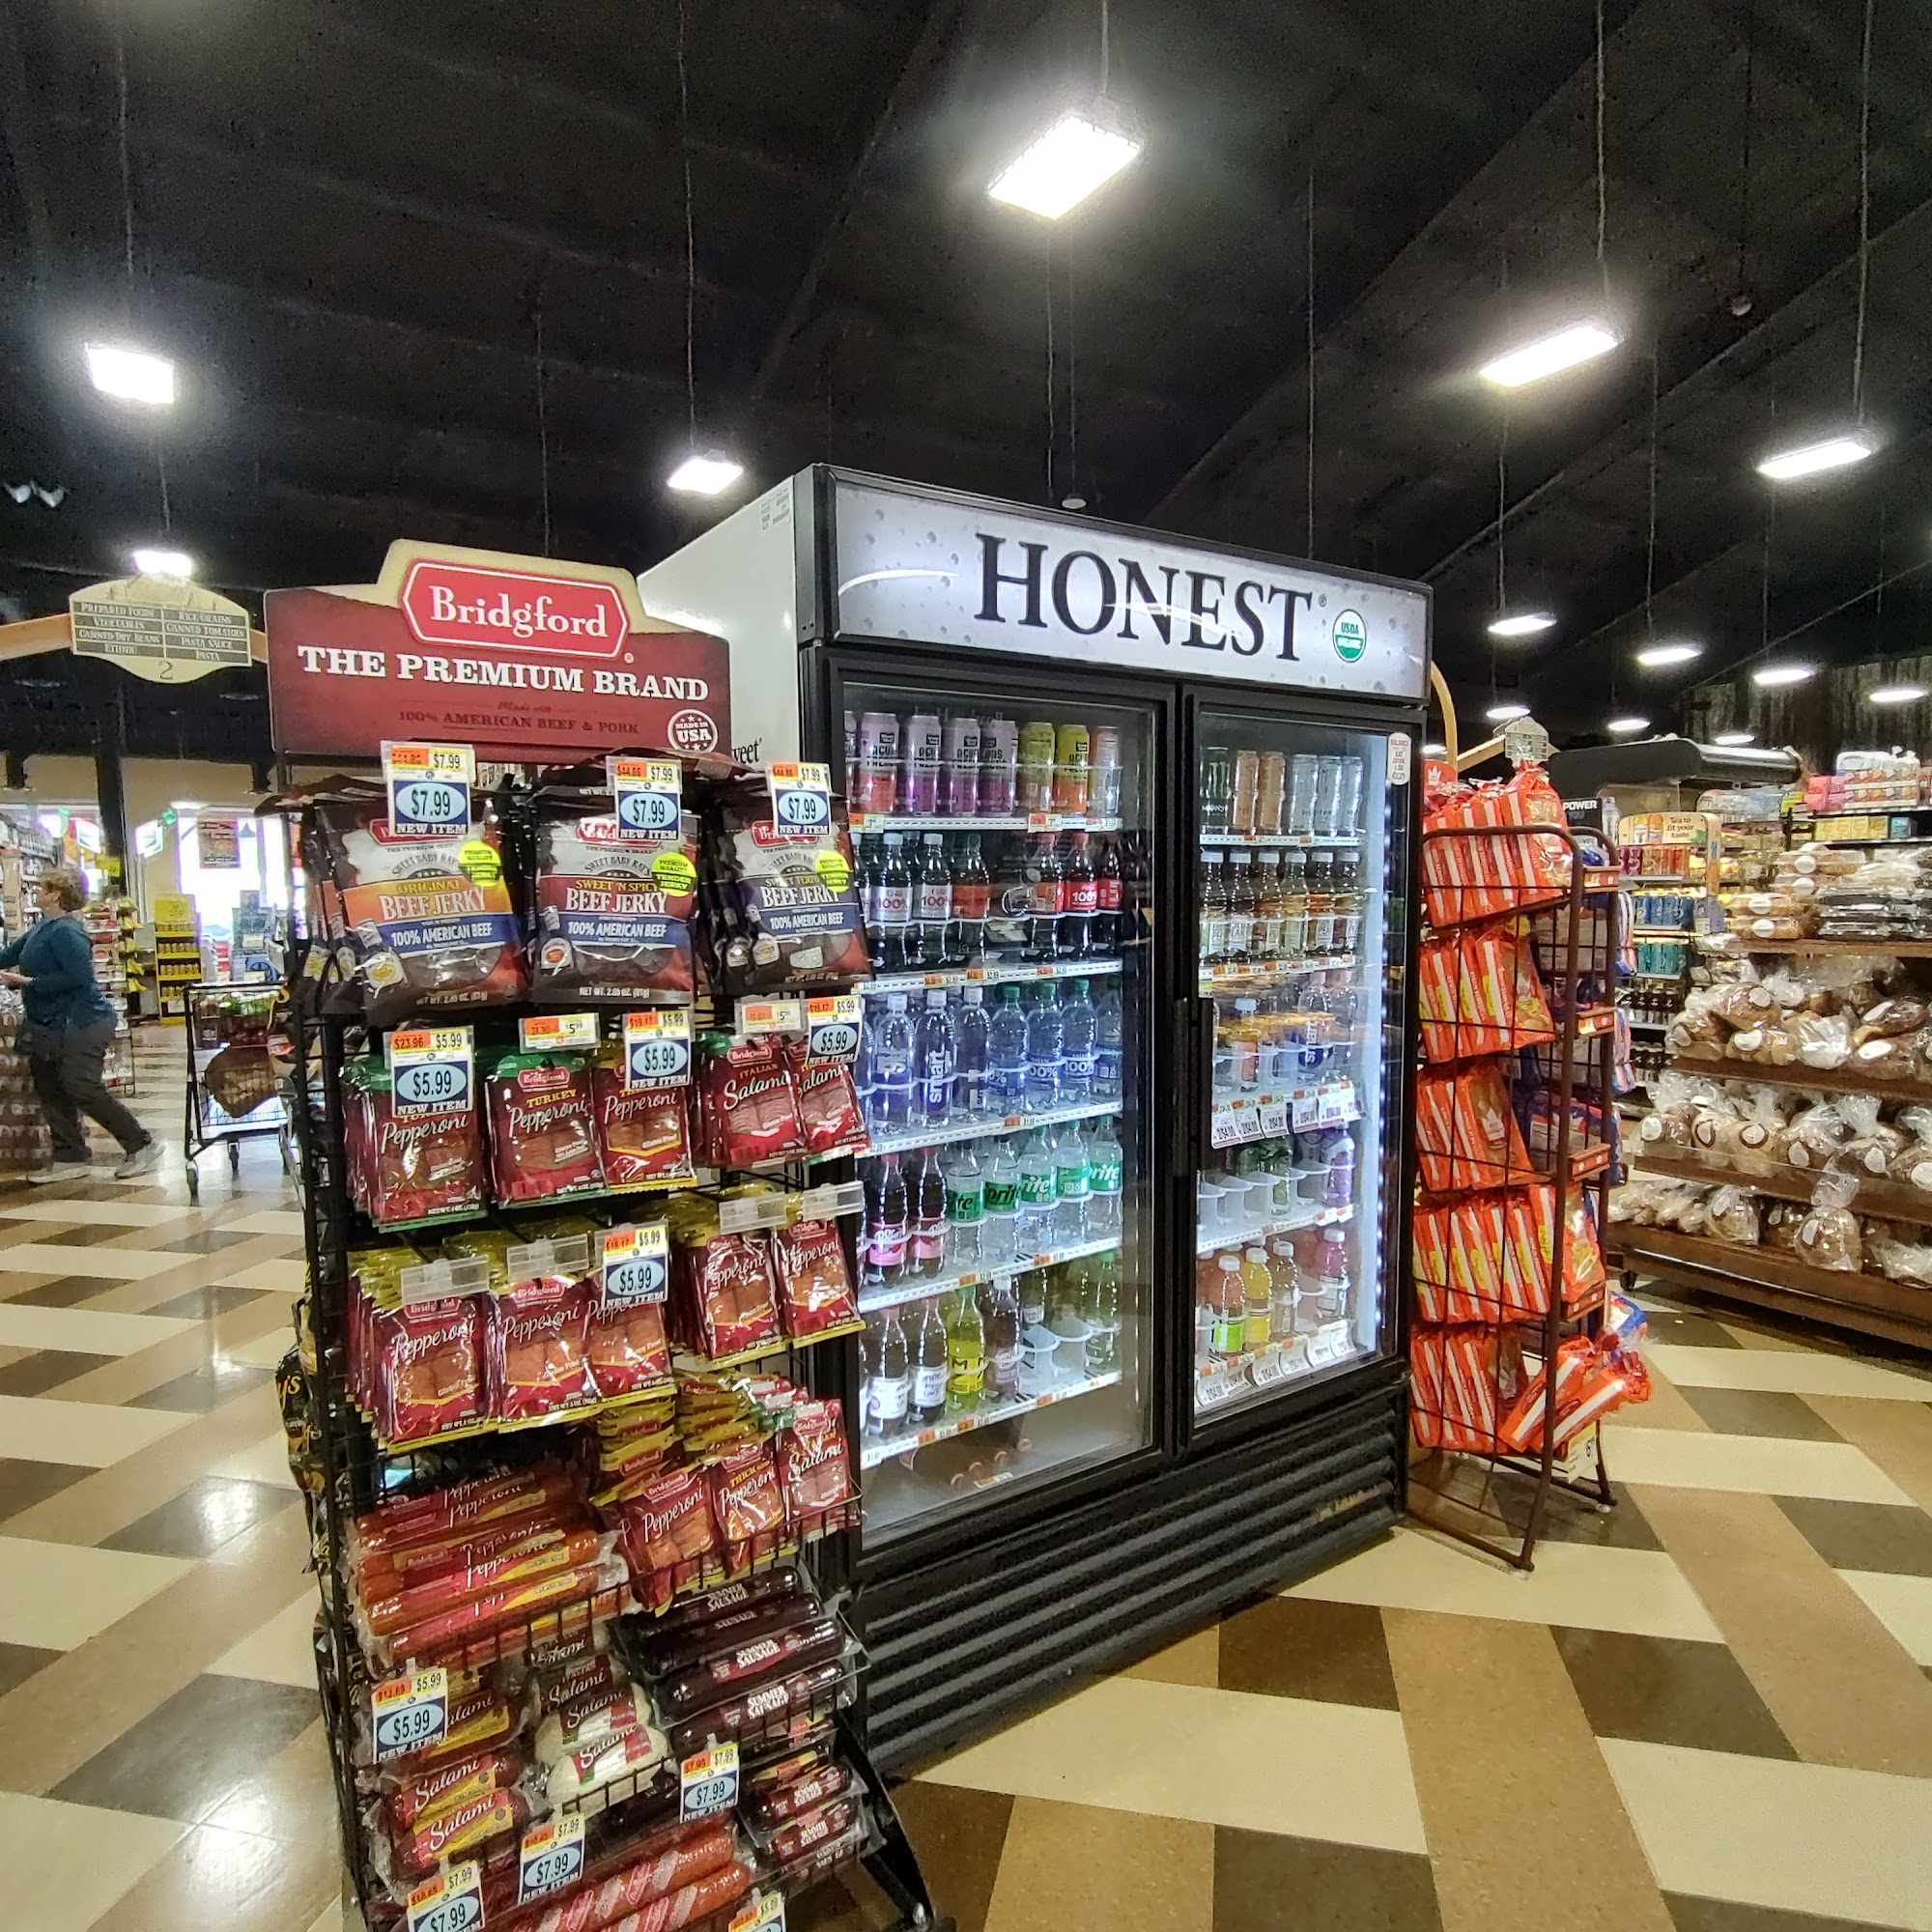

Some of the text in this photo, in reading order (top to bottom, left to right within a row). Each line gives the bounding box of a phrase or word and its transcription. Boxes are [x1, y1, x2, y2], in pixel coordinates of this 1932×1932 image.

[975, 532, 1312, 662] HONEST
[429, 584, 608, 639] Bridgford
[1341, 622, 1358, 635] USDA
[196, 650, 220, 661] PASTA
[158, 662, 173, 680] 2
[298, 646, 709, 701] THE PREMIUM BRAND
[398, 711, 438, 723] 100%
[443, 714, 530, 727] AMERICAN
[537, 719, 575, 729] BEEF
[598, 723, 639, 734] PORK
[676, 728, 712, 743] USA
[434, 754, 460, 769] $7.99
[651, 766, 672, 781] $7.99
[412, 789, 450, 818] $7.99
[634, 801, 665, 823] $7.99
[788, 797, 816, 820] $7.99
[1563, 799, 1598, 811] POWER
[396, 824, 466, 834] NEW ITEM
[620, 829, 644, 839] NEW
[648, 830, 677, 839] ITEM
[780, 825, 803, 835] NEW
[806, 825, 828, 835] ITEM
[576, 880, 613, 891] SWEET
[629, 882, 659, 892] SPICY
[760, 887, 798, 907] BEEF
[379, 887, 485, 921] BEEF JERKY
[566, 887, 668, 913] BEEF JERKY
[568, 922, 667, 937] 100% AMERICAN BEEF
[770, 912, 843, 929] 100% AMERICAN BEEF
[390, 923, 494, 947] 100% AMERICAN BEEF
[580, 987, 592, 996] NET
[837, 1001, 855, 1013] $5.99
[663, 1013, 684, 1027] $5.99
[436, 1033, 463, 1048] $5.99
[820, 1030, 848, 1052] $5.99
[644, 1044, 676, 1071] $5.99
[831, 1053, 854, 1063] ITEM
[631, 1074, 687, 1089] NEW ITEM
[739, 1064, 778, 1079] ITALIAN
[412, 1069, 452, 1098] $5.99
[397, 1099, 468, 1116] NEW ITEM
[526, 1089, 577, 1108] TURKEY
[604, 1092, 678, 1125] Pepperoni
[509, 1094, 587, 1138] Pepperoni
[381, 1114, 471, 1155] Pepperoni
[639, 1230, 661, 1246] $5.99
[619, 1267, 652, 1293] $5.99
[607, 1291, 665, 1307] NEW ITEM
[501, 1301, 580, 1344] Pepperoni
[647, 1473, 685, 1495] Bridgford
[729, 1468, 756, 1487] THICK
[642, 1481, 704, 1543] Pepperoni
[707, 1590, 750, 1613] SAUSAGE
[736, 1639, 773, 1660] SUMMER
[737, 1644, 781, 1669] SAUSAGE
[417, 1673, 441, 1692] $5.99
[549, 1667, 606, 1707] Salami
[747, 1685, 784, 1706] SUMMER
[748, 1694, 789, 1719] SAUSAGE
[447, 1695, 495, 1731] alami
[567, 1690, 624, 1730] Salami
[393, 1709, 430, 1741] $5.99
[379, 1731, 443, 1762] NEW ITEM
[715, 1748, 733, 1766] $7.99
[414, 1758, 481, 1813] Salami
[696, 1780, 724, 1805] $7.99
[428, 1793, 496, 1852] Salami
[684, 1809, 706, 1821] NEW
[557, 1818, 580, 1837] $7.99
[449, 1867, 471, 1889] $7.99
[536, 1852, 569, 1884] $7.99
[431, 1903, 466, 1932] $7.99
